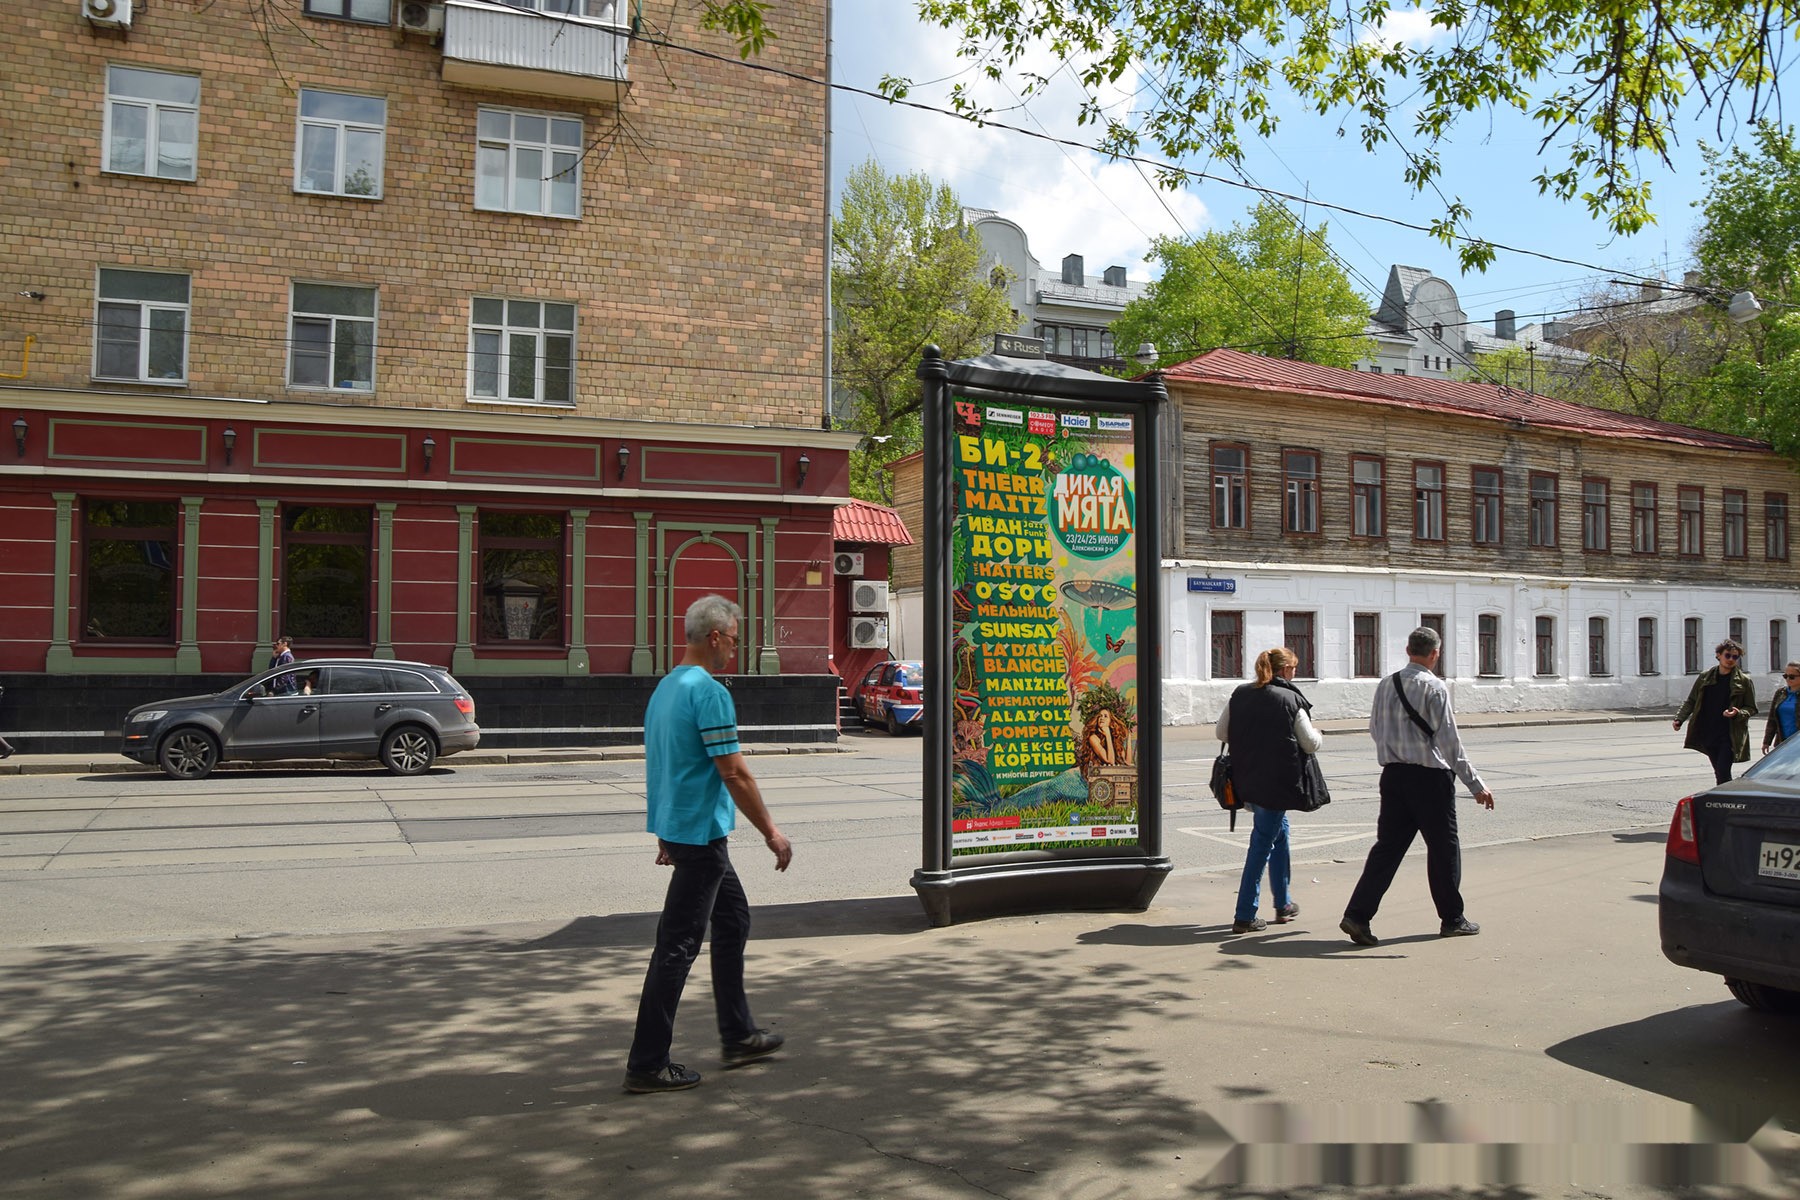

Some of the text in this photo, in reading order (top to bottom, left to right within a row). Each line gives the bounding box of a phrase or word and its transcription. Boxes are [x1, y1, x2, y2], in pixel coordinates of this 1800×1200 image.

[1014, 341, 1040, 353] Russ
[996, 412, 1021, 420] SENNHEISER
[1063, 416, 1088, 427] Haier
[959, 435, 1042, 470] БИ-2
[963, 469, 1045, 495] THERR
[1053, 474, 1123, 498] ДИКАЯ
[965, 490, 1048, 515] MAITZ
[1058, 494, 1131, 531] МЯТА
[968, 516, 1022, 535] ИВАН
[1024, 520, 1048, 530] Jazzy
[1024, 529, 1048, 539] Funky
[1066, 534, 1119, 545] 23/24/25 ИЮНЯ
[971, 535, 1053, 559] ДОРН
[1072, 544, 1104, 553] Алексинский
[979, 563, 1055, 580] HATTERS
[978, 604, 1059, 621] МЕЛЬНИЦА
[980, 622, 1060, 639] SUNSAY
[982, 643, 1065, 658] LA DAME
[983, 658, 1067, 673] BLANCHE
[986, 677, 1068, 691] MANIZHA
[988, 694, 1071, 707] КРЕМАТОРИЙ
[991, 710, 1072, 722] ALAI OLI
[991, 725, 1073, 739] POMPEYA
[994, 739, 1075, 754] АЛЕКСЕЙ
[994, 752, 1077, 767] КОРТНЕВ
[1002, 771, 1028, 779] МНОГИЕ
[1029, 770, 1055, 778] ДРУГИЕ
